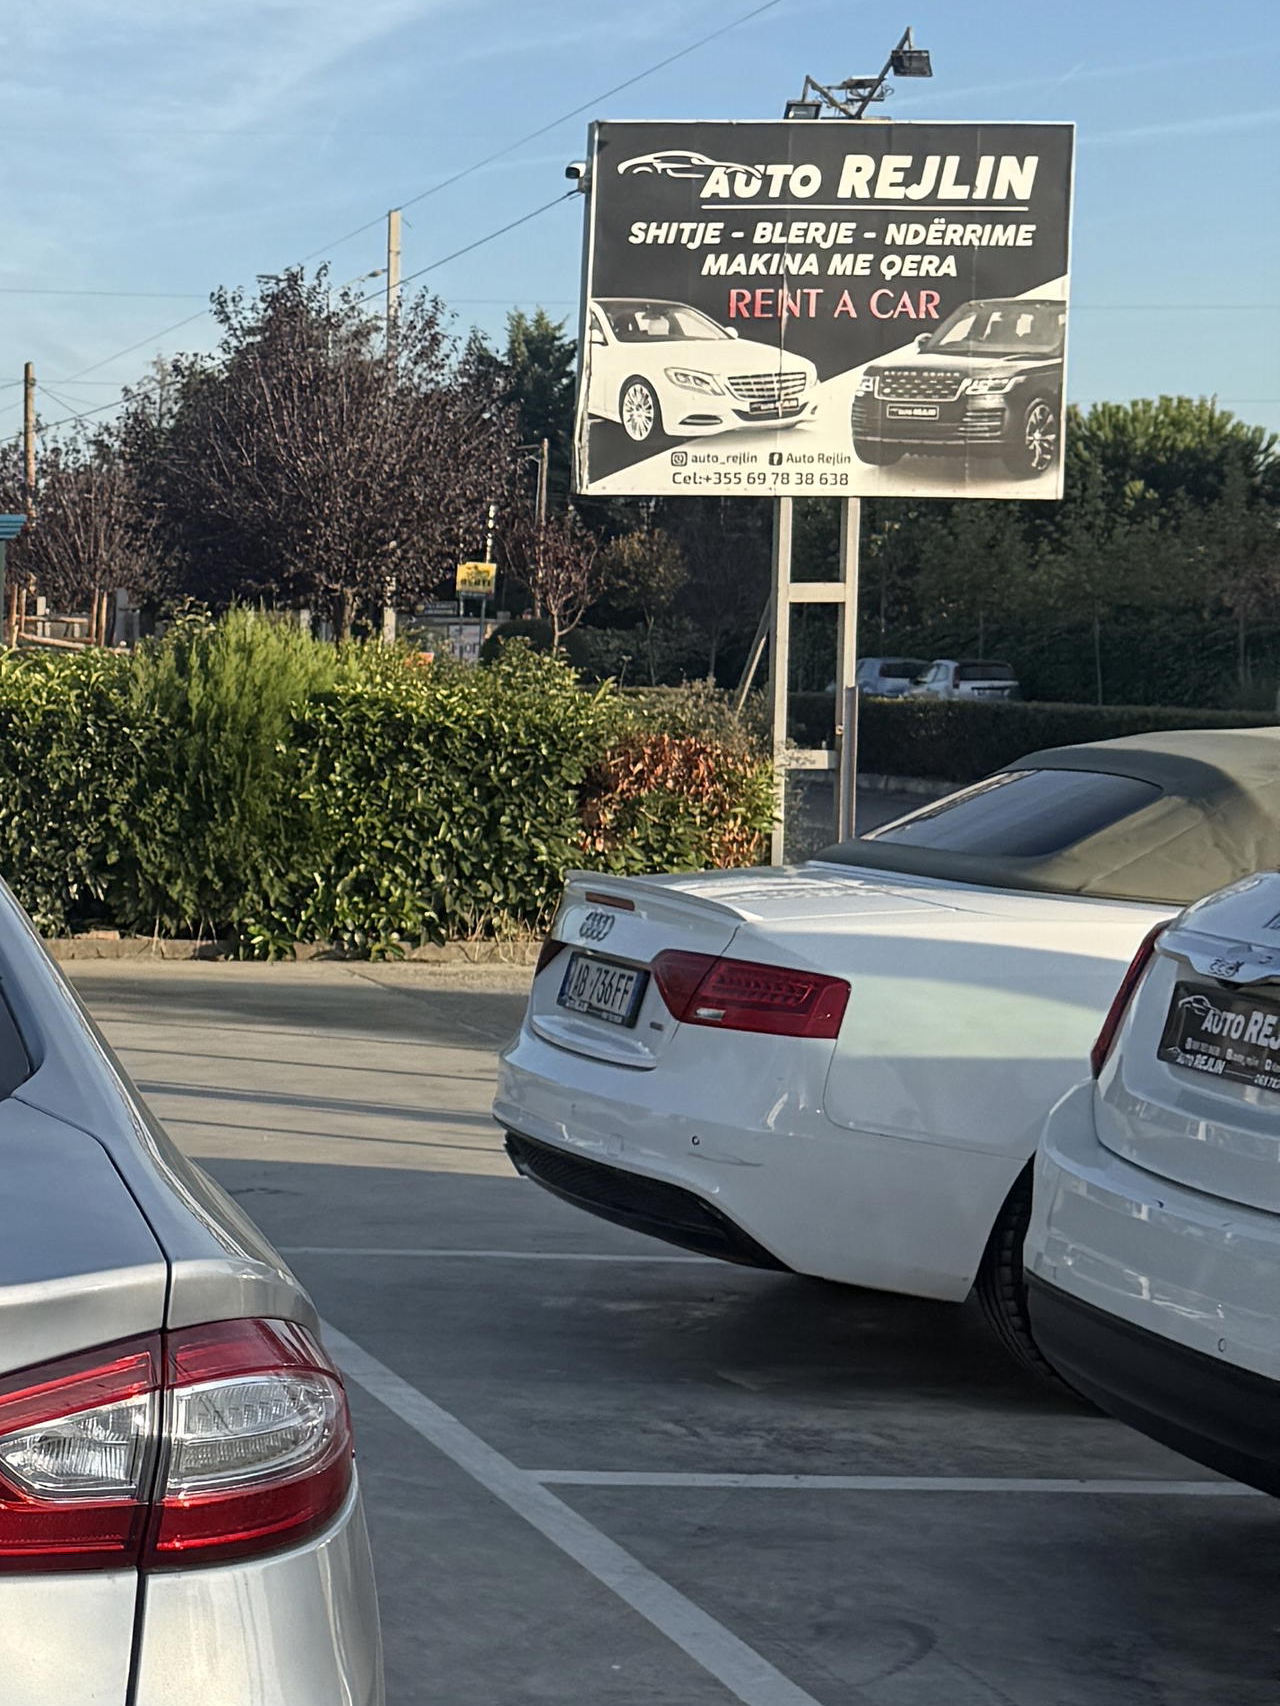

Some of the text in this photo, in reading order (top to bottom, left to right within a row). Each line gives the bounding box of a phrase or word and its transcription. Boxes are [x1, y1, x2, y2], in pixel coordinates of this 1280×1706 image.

[699, 154, 1039, 201] AUTO REJLIN
[628, 221, 725, 250] SHITJE
[752, 221, 857, 250] BLERJE
[884, 217, 1037, 248] NDËRRIME
[701, 253, 958, 281] MAKINA ME QERA
[728, 288, 942, 320] RENT A CAR
[691, 452, 758, 466] auto_rejlin
[786, 452, 852, 467] Auto Rejlin
[672, 472, 849, 486] Cel:+355 69 78 38 638
[1201, 1009, 1245, 1040] AUTO
